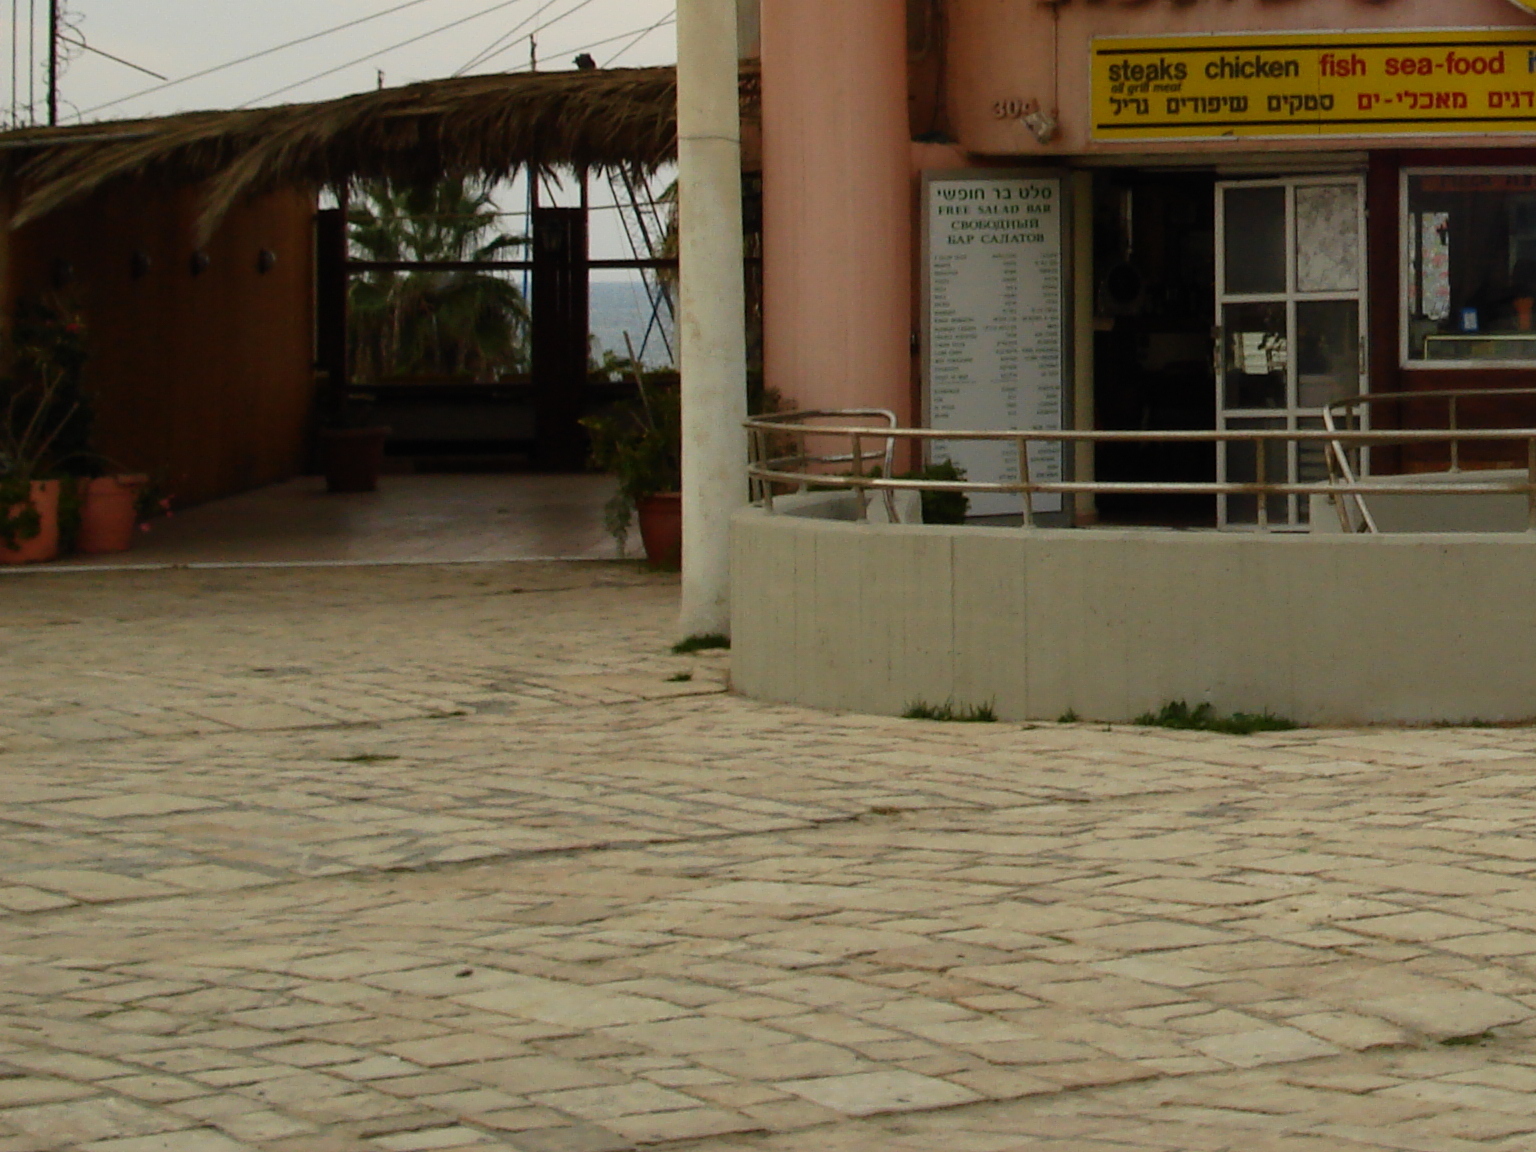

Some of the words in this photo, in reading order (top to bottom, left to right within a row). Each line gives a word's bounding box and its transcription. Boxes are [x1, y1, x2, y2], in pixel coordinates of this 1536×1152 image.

[1108, 57, 1188, 81] steaks
[1204, 55, 1300, 79] chicken
[1319, 54, 1367, 77] fish
[1385, 51, 1505, 76] sea-food
[1109, 97, 1150, 116] גריל
[1166, 95, 1249, 115] שיפודים
[1266, 94, 1335, 116] סטקים
[1488, 90, 1535, 109] דגים
[1018, 184, 1053, 200] סלט
[978, 204, 1020, 215] SALAD
